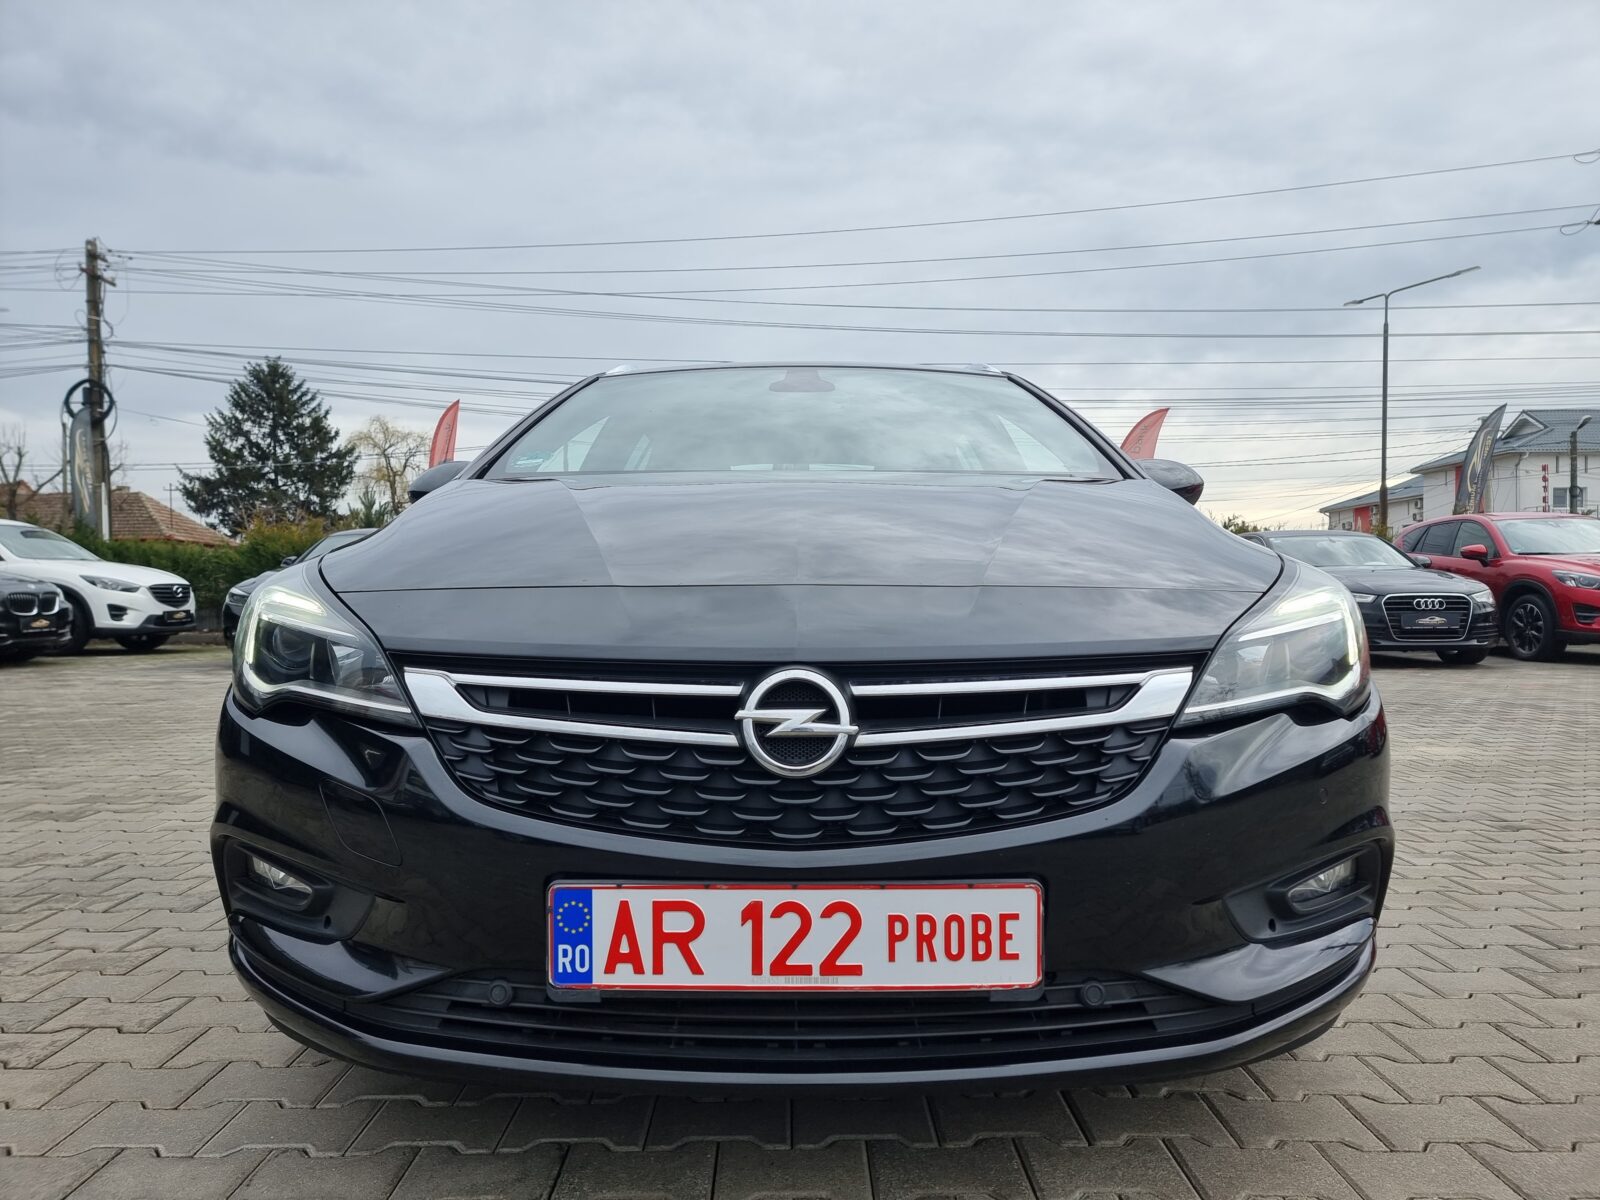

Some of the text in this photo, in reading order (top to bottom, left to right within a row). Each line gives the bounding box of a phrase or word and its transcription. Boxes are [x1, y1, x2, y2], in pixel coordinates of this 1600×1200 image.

[557, 944, 590, 973] RO
[603, 900, 1020, 977] AR 122 PROBE
